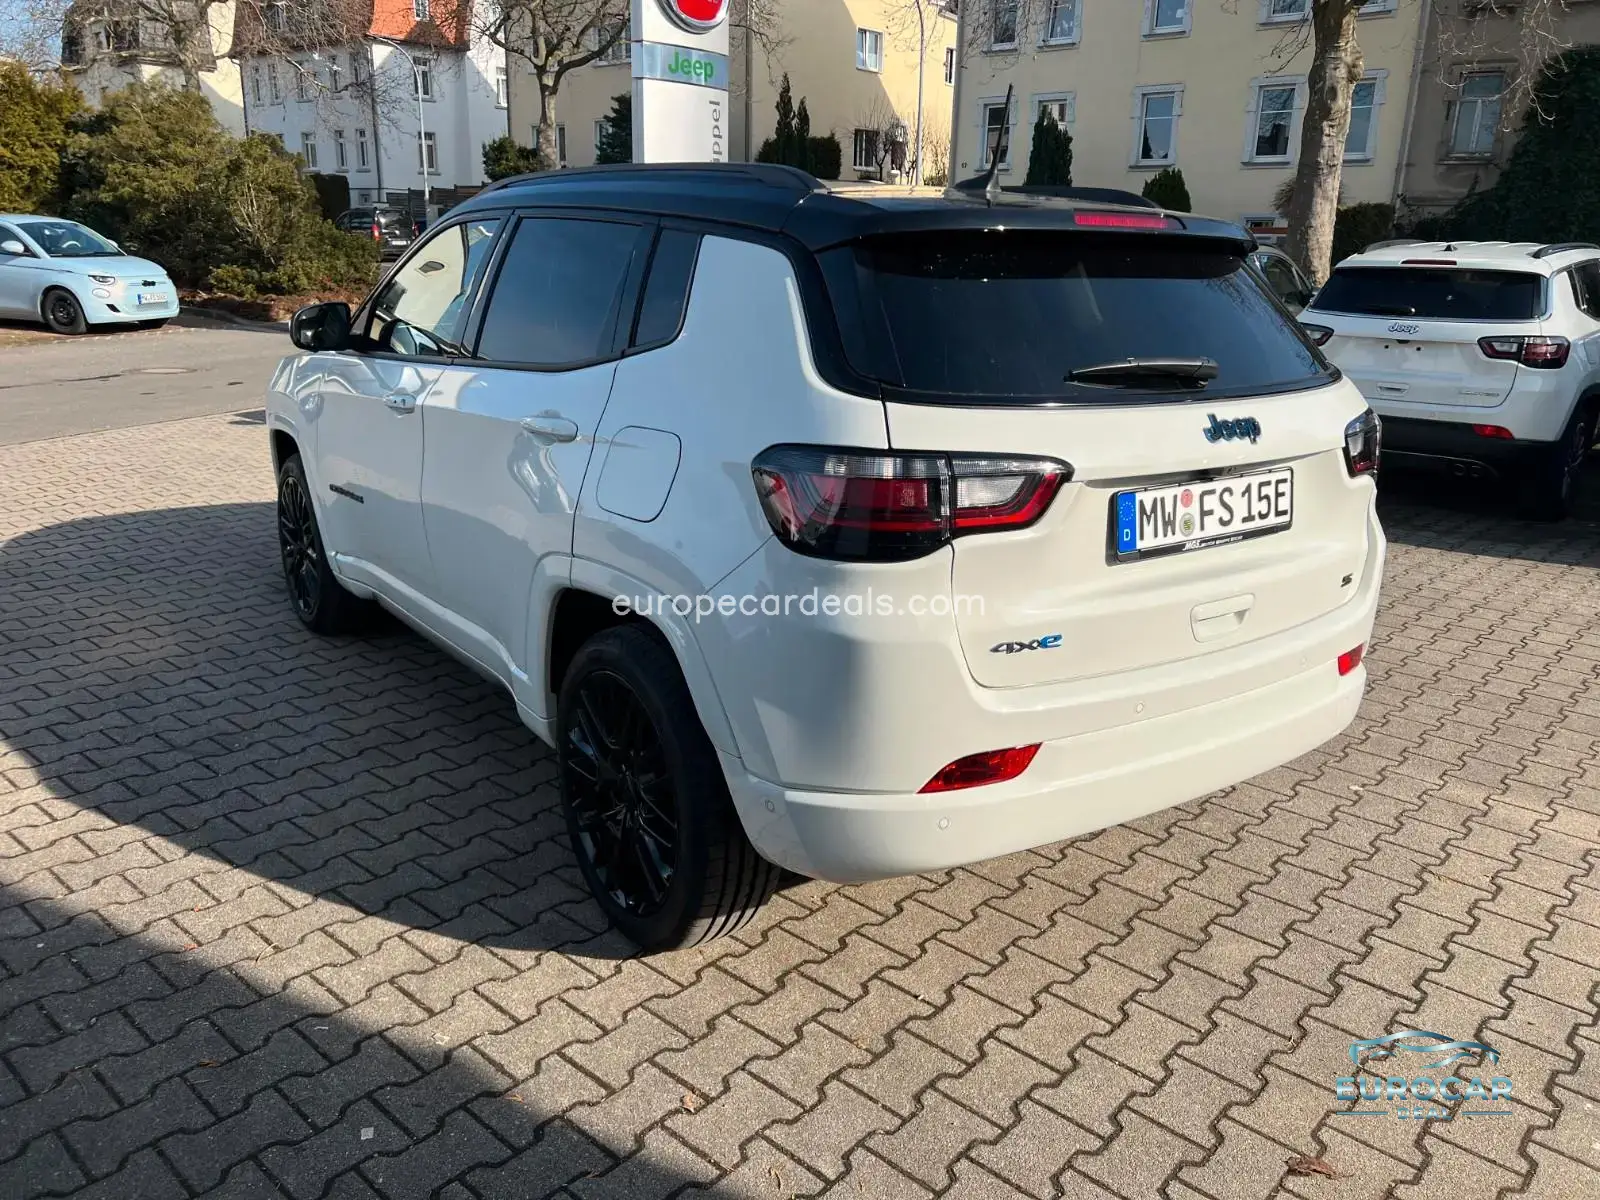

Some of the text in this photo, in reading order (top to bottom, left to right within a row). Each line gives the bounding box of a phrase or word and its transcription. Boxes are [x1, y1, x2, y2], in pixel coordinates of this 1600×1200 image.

[668, 52, 714, 82] Jeep
[1387, 322, 1420, 335] Jeep
[1203, 413, 1262, 444] Jeep
[1139, 478, 1289, 541] MW FS 15E
[1123, 528, 1132, 541] D
